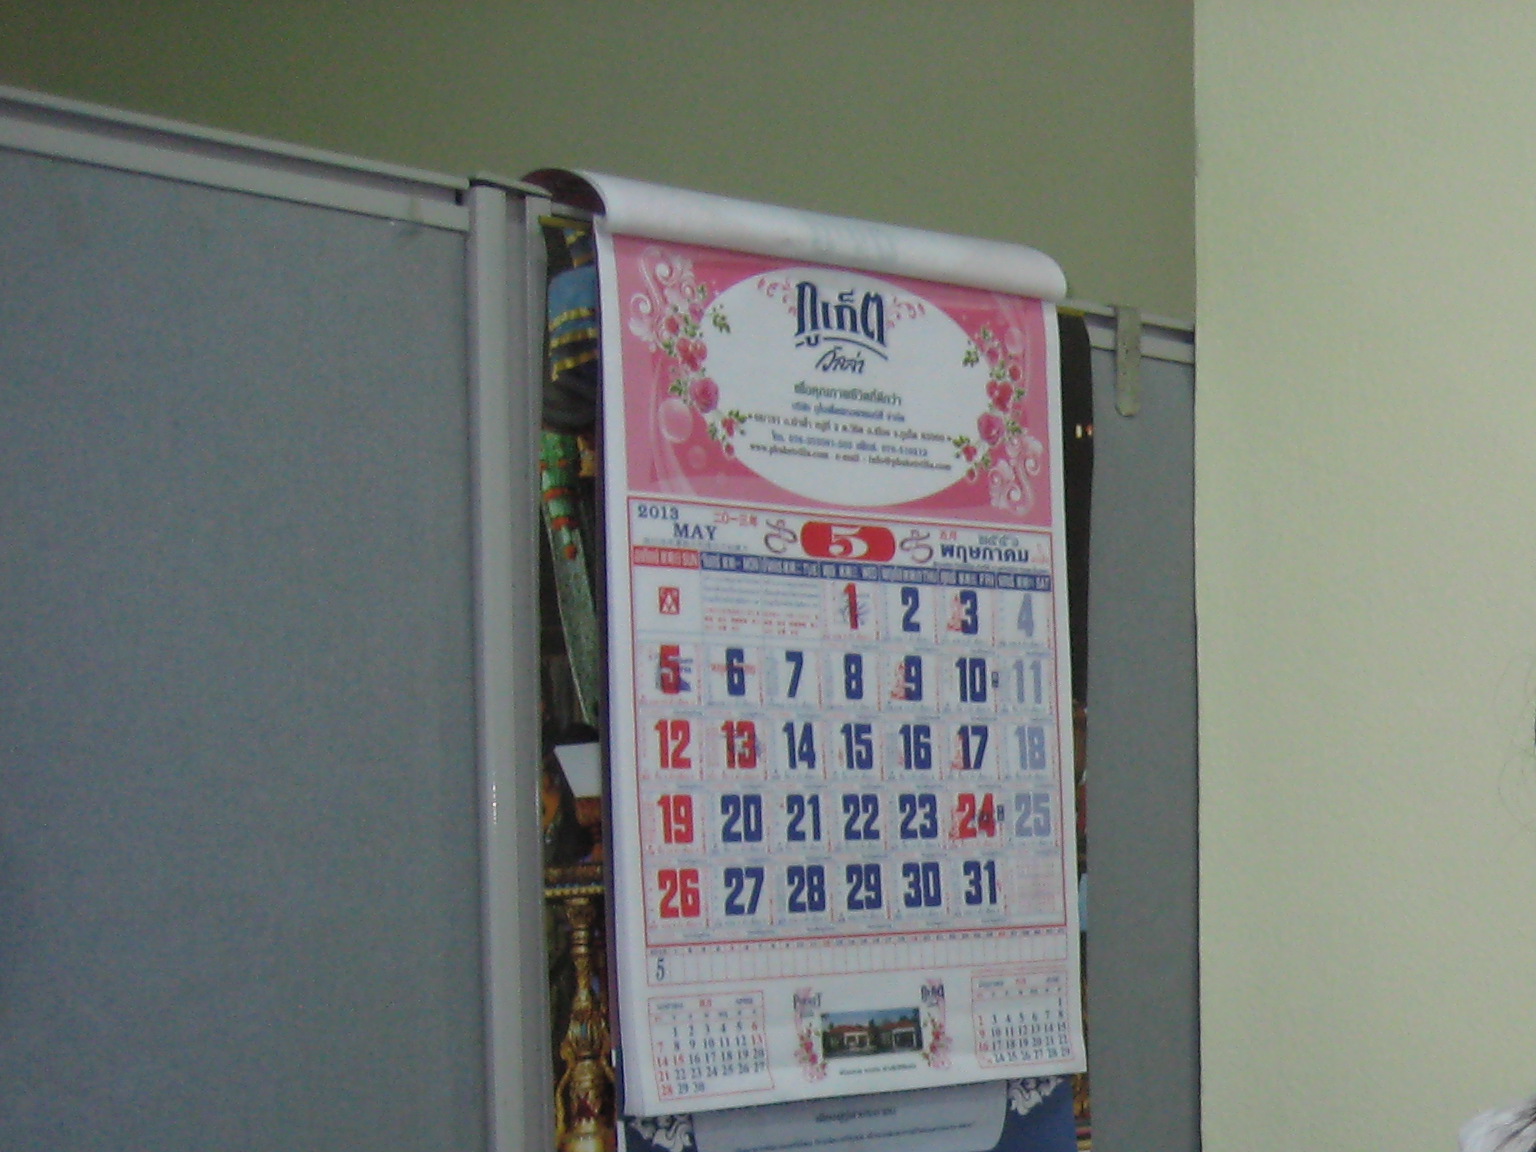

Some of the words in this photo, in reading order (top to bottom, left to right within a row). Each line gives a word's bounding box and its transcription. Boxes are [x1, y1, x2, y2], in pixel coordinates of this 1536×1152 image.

[638, 504, 679, 521] 2013
[673, 522, 717, 541] MAY
[828, 526, 870, 557] 5
[940, 543, 1029, 563] พฤษภาคม
[843, 582, 859, 630] 1
[901, 586, 920, 632] 2
[959, 589, 978, 635] 3
[1017, 593, 1034, 637] 4
[659, 644, 680, 694] 5
[725, 648, 746, 696] 6
[785, 650, 804, 698] 7
[844, 653, 863, 700] 8
[904, 655, 923, 702] 9
[955, 657, 987, 703] 10
[1012, 659, 1042, 704] 11
[654, 719, 692, 769] 12
[721, 720, 757, 769] 13
[782, 722, 816, 769] 14
[840, 723, 873, 770] 15
[899, 724, 932, 770] 16
[957, 725, 989, 770] 17
[1014, 725, 1046, 770] 18
[657, 794, 694, 844] 19
[720, 794, 763, 842] 20
[786, 794, 822, 841] 21
[842, 793, 881, 841] 22
[899, 793, 938, 840] 23
[957, 793, 997, 839] 24
[1014, 793, 1051, 837] 25
[657, 868, 700, 919] 26
[723, 867, 765, 916] 27
[787, 865, 826, 913] 28
[845, 863, 882, 911] 29
[902, 862, 942, 908] 30
[963, 860, 997, 905] 31
[656, 957, 665, 982] 5
